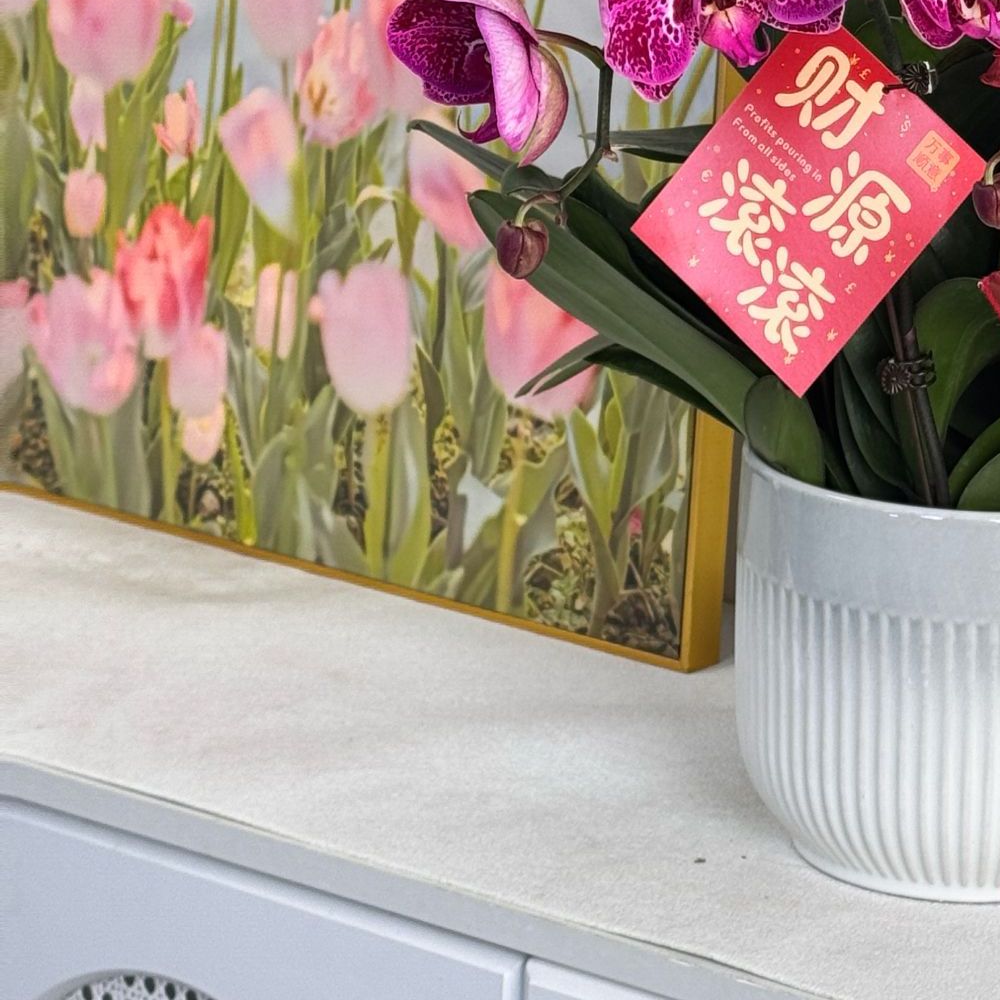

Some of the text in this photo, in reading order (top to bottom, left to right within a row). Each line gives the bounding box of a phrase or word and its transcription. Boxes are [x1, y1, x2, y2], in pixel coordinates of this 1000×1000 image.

[732, 116, 797, 182] From all sides
[743, 103, 823, 182] Profits pouring in
